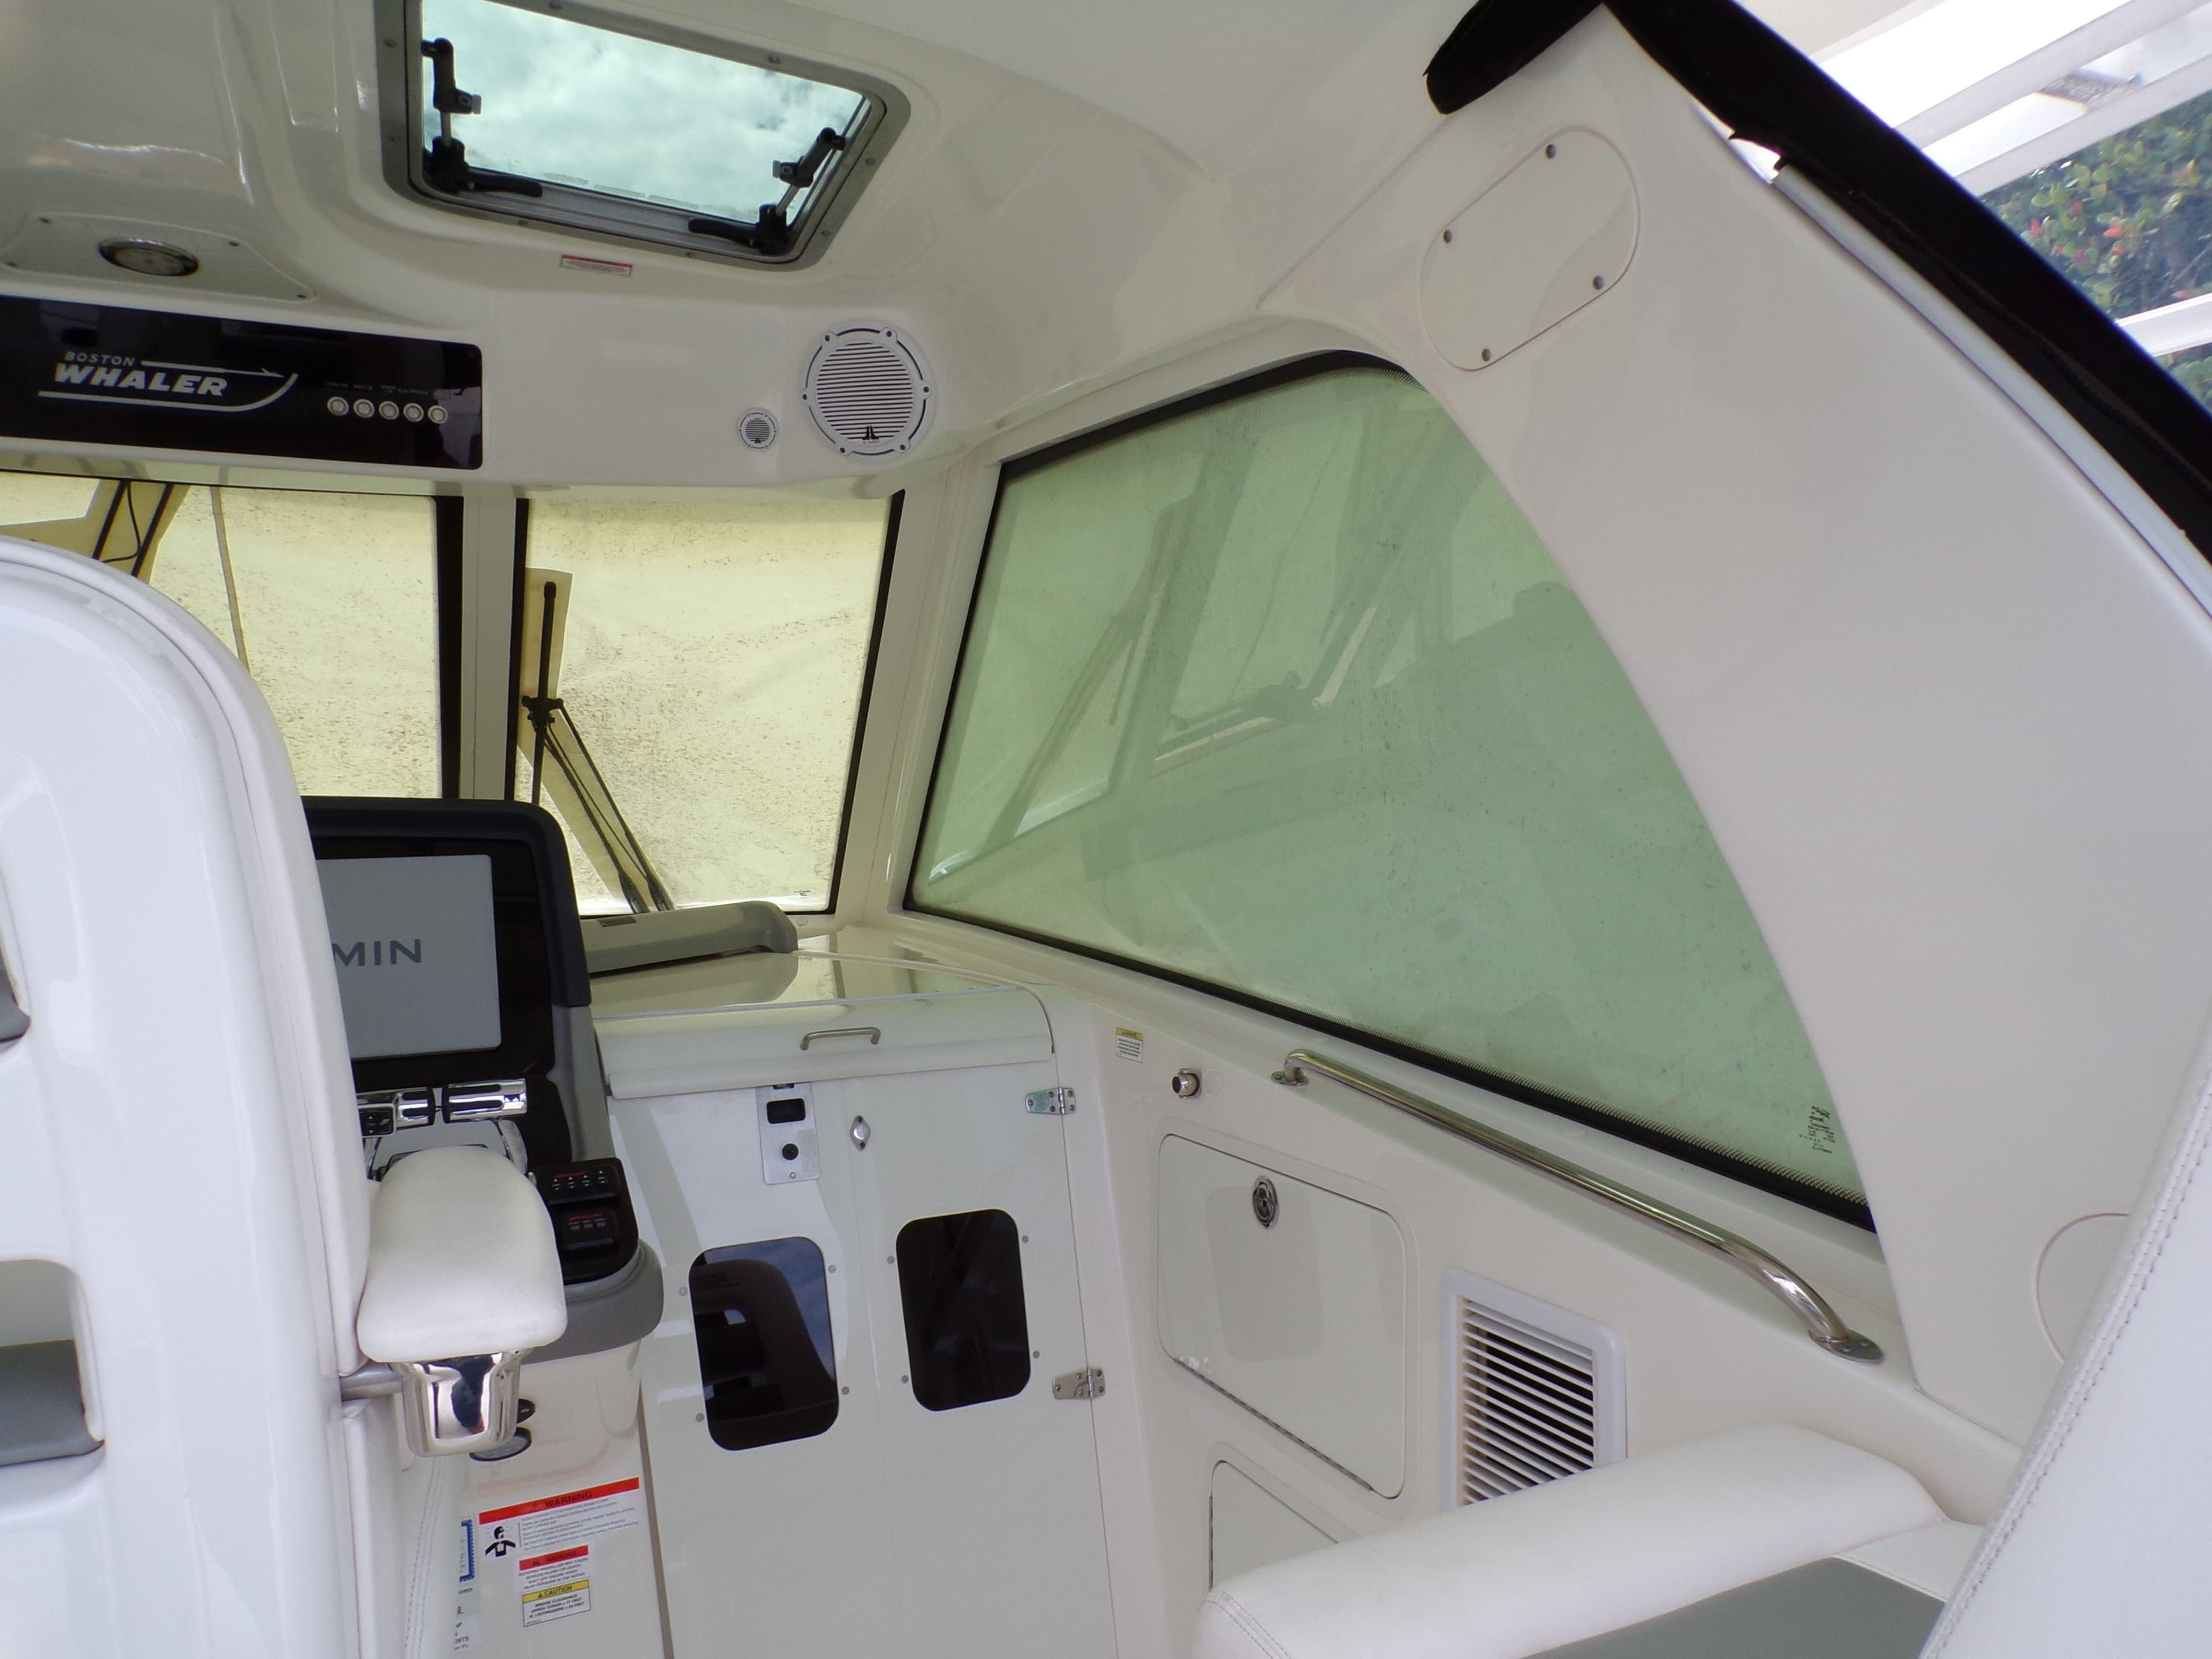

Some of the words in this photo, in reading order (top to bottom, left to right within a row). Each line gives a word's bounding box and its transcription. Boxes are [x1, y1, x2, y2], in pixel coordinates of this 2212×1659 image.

[63, 350, 135, 367] BOSTON
[54, 362, 229, 397] WHALER
[544, 1491, 593, 1507] WARNING
[543, 1584, 573, 1596] CAUTION
